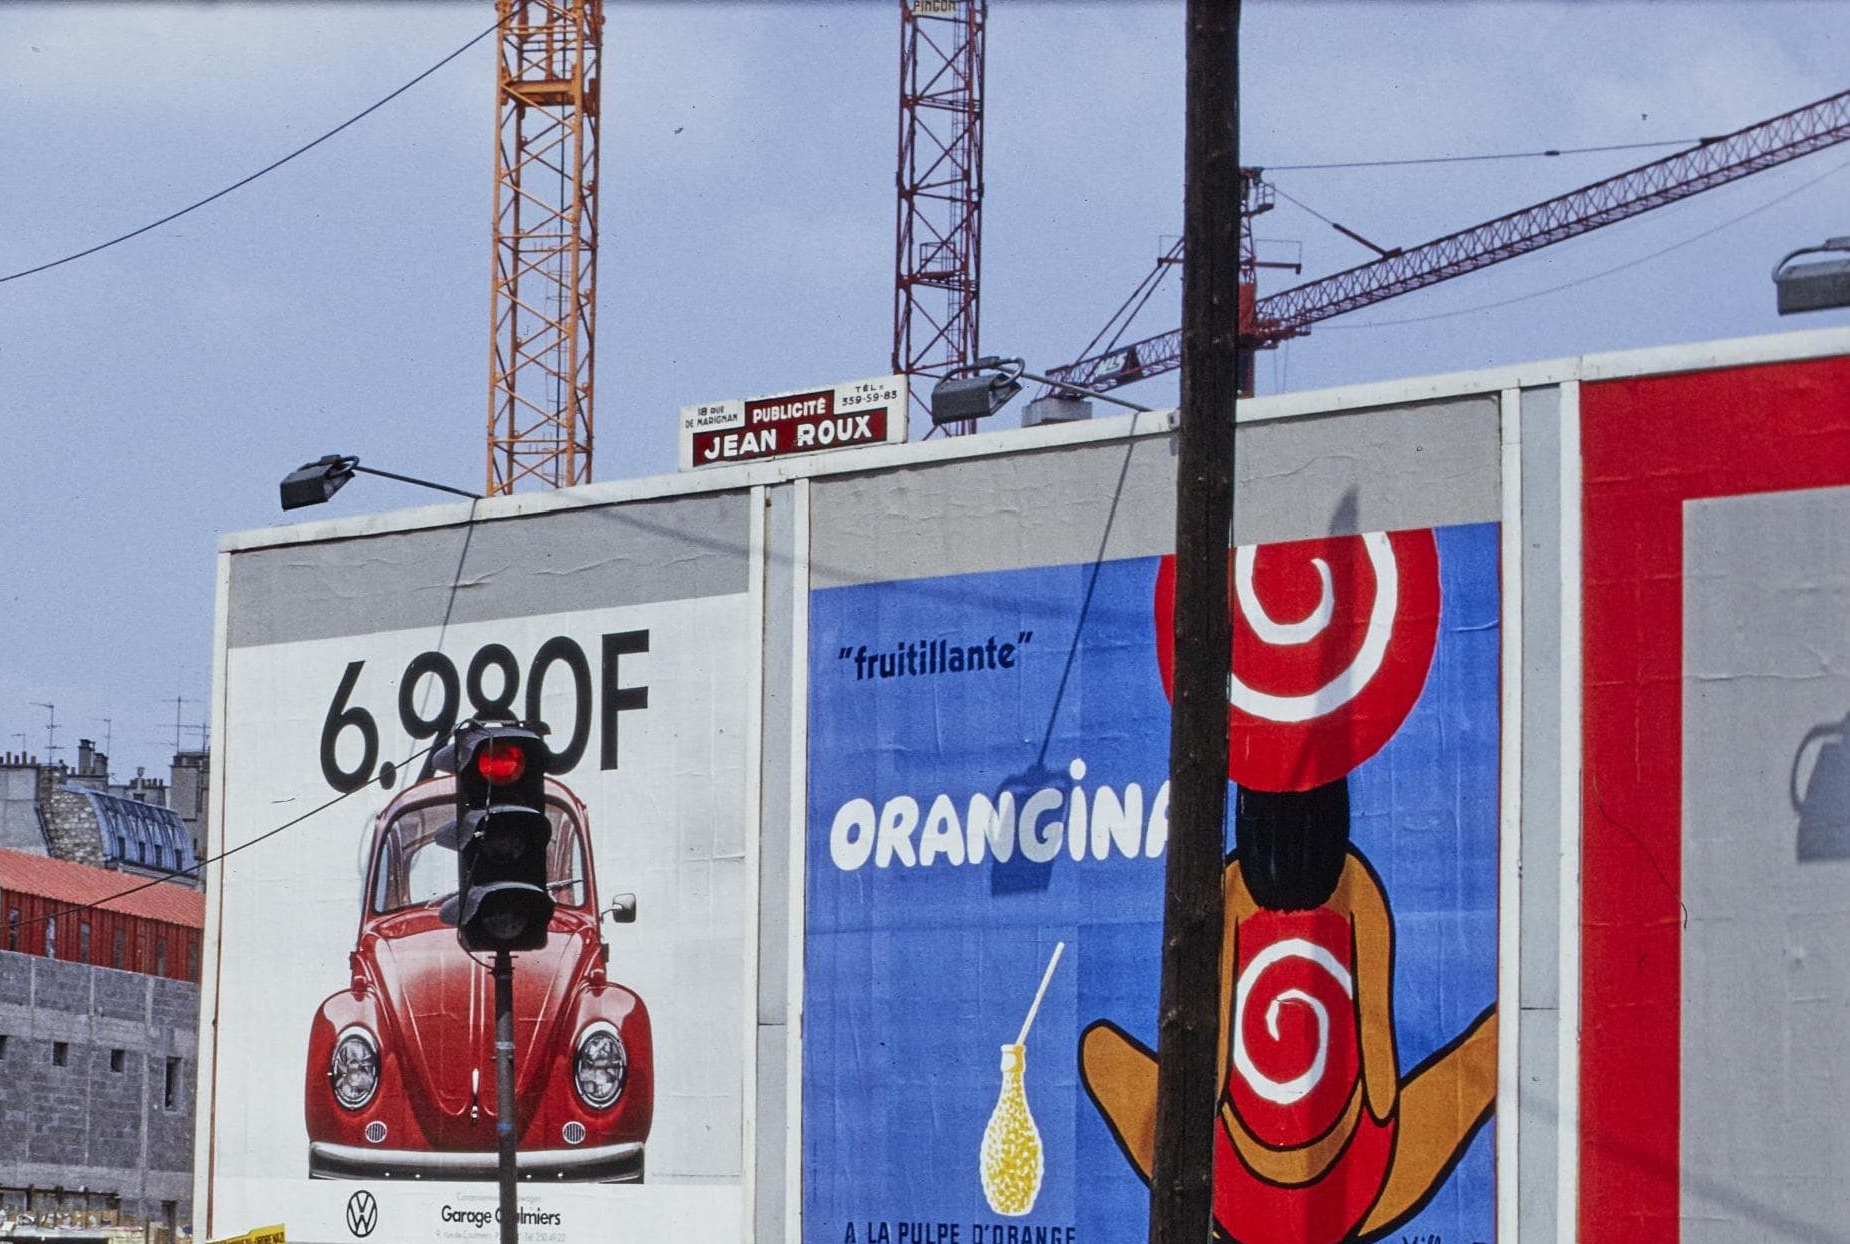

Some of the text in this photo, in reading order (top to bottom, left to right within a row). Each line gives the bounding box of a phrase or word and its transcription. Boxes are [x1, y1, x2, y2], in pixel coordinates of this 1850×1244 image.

[685, 414, 738, 429] DE MARIGNAN
[752, 398, 826, 424] PUBLICITÉ
[704, 415, 872, 460] JEAN ROUX
[441, 1204, 492, 1229] Garage
[868, 1221, 890, 1244] LA
